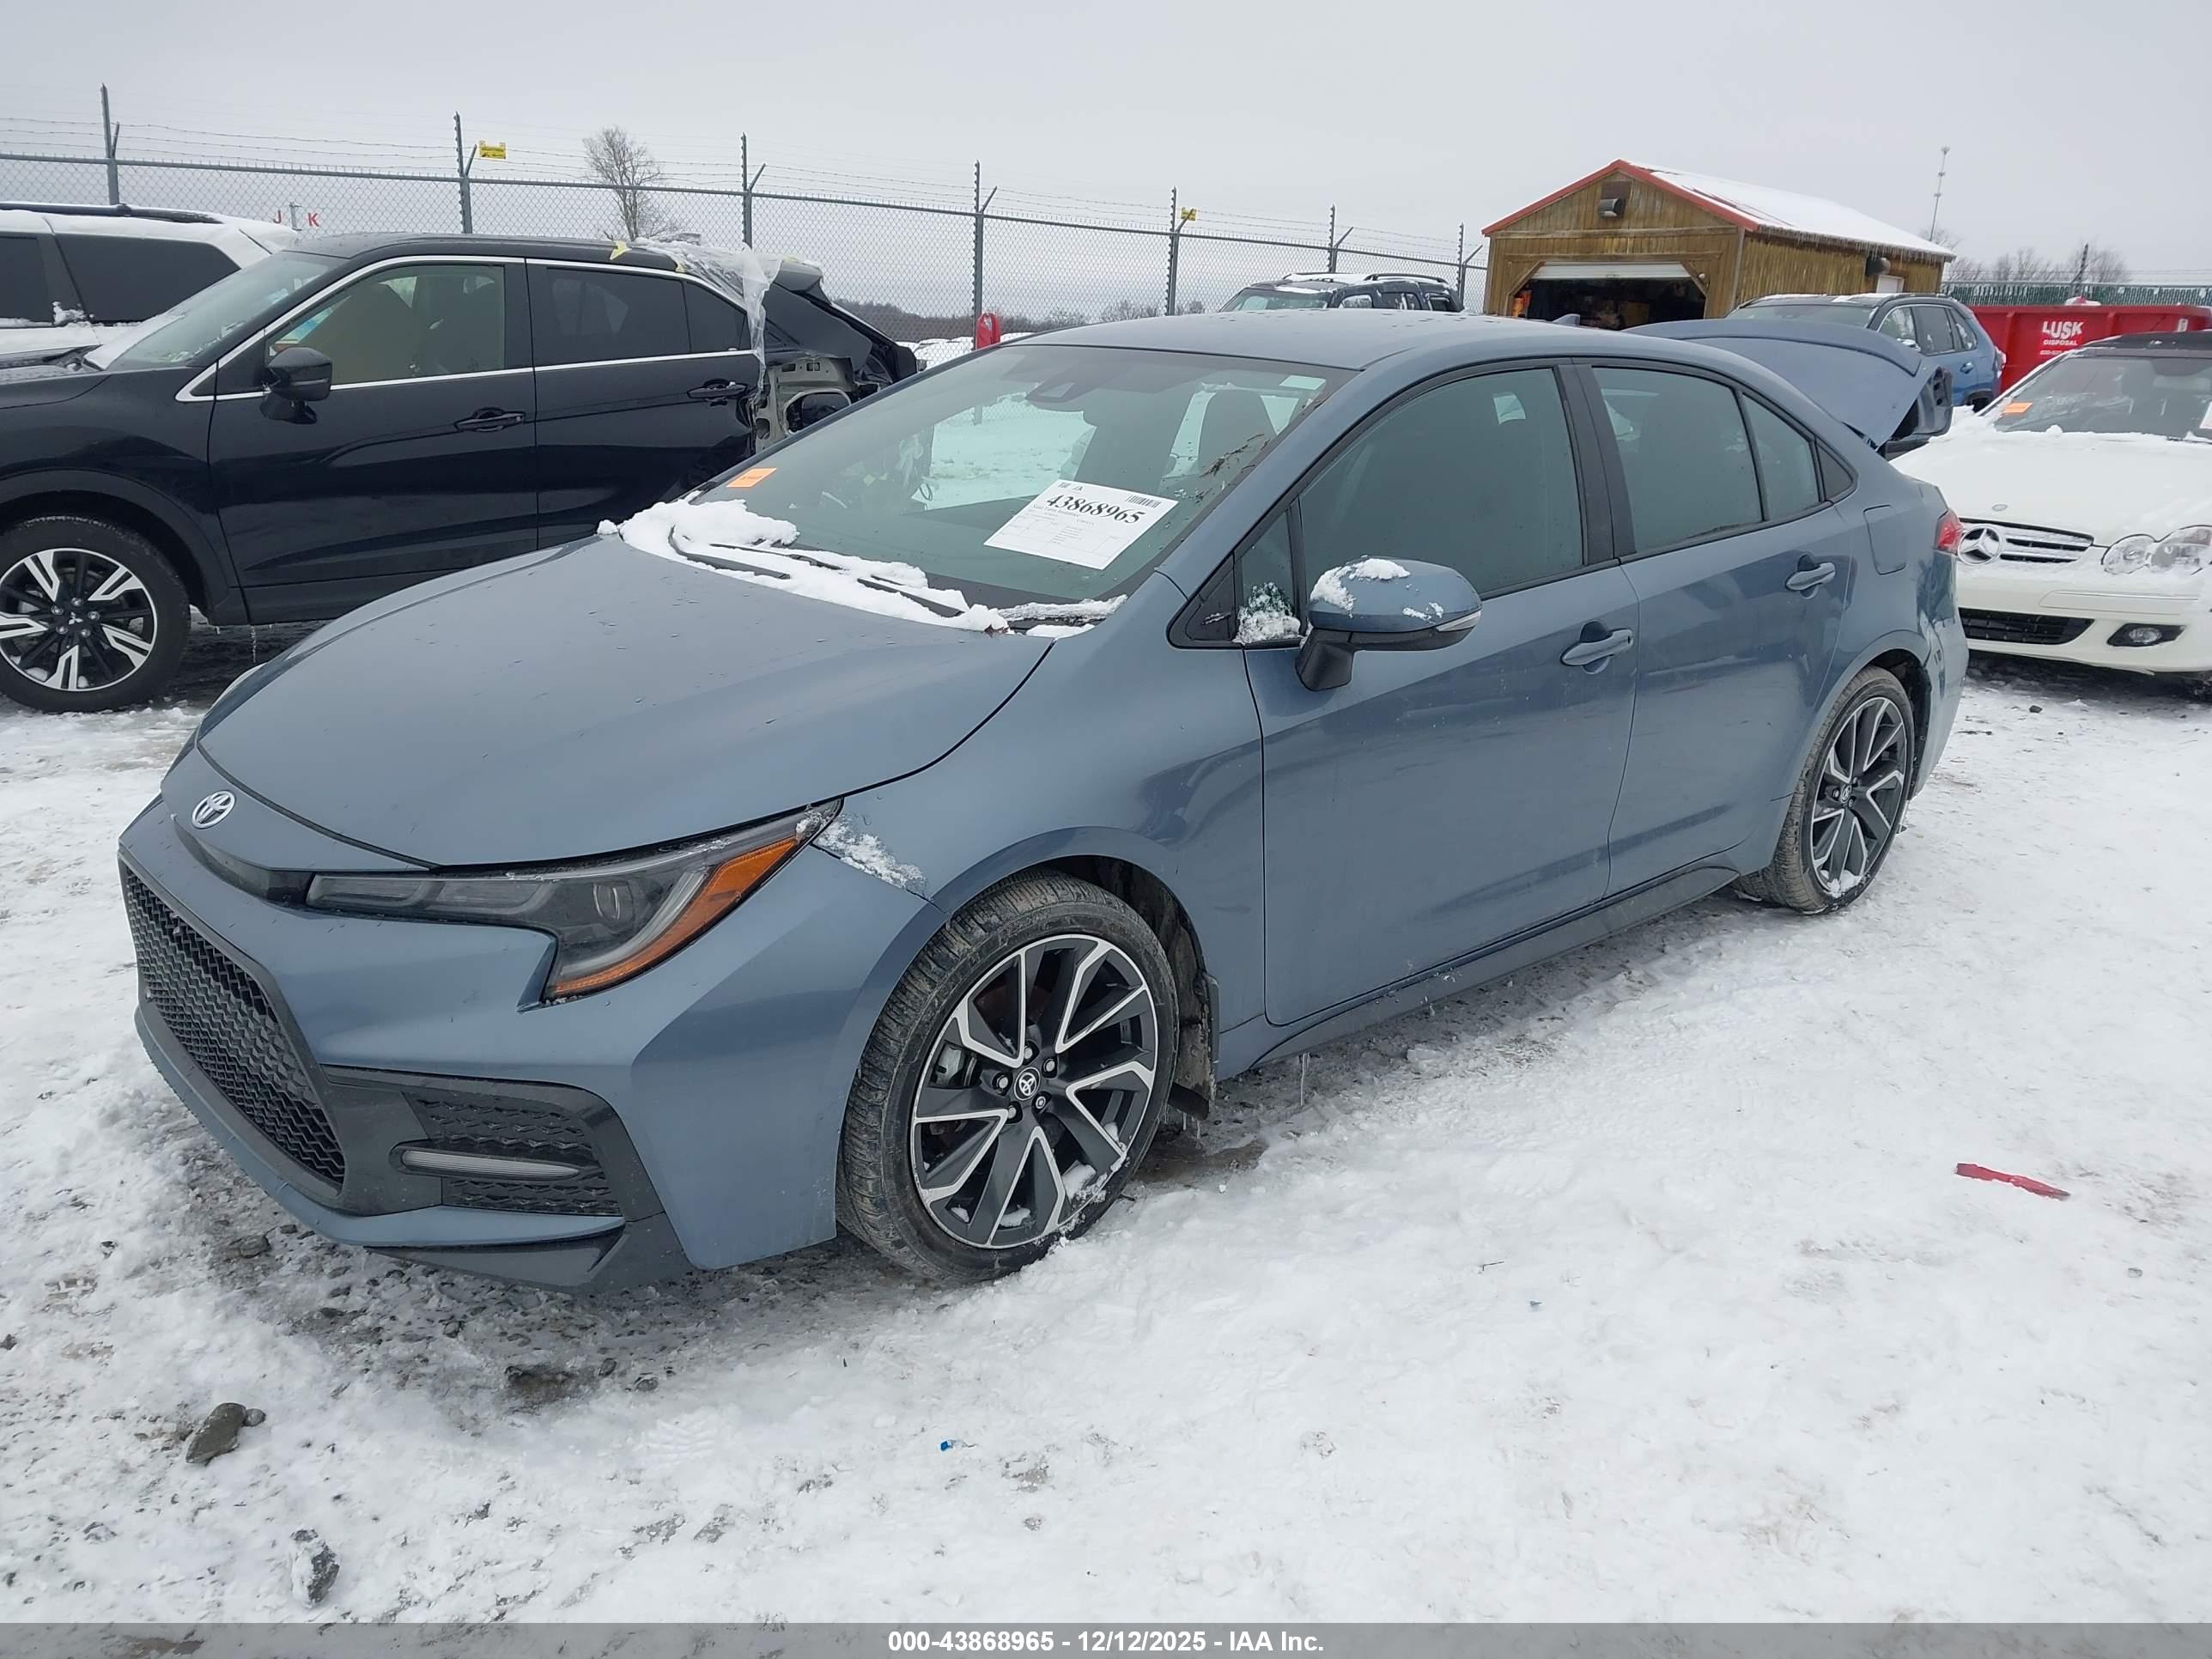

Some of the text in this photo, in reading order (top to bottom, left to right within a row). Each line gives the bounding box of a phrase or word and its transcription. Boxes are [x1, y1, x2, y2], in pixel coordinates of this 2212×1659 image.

[273, 210, 320, 227] J K
[2042, 321, 2084, 339] LUSK
[1046, 495, 1146, 524] 43868965
